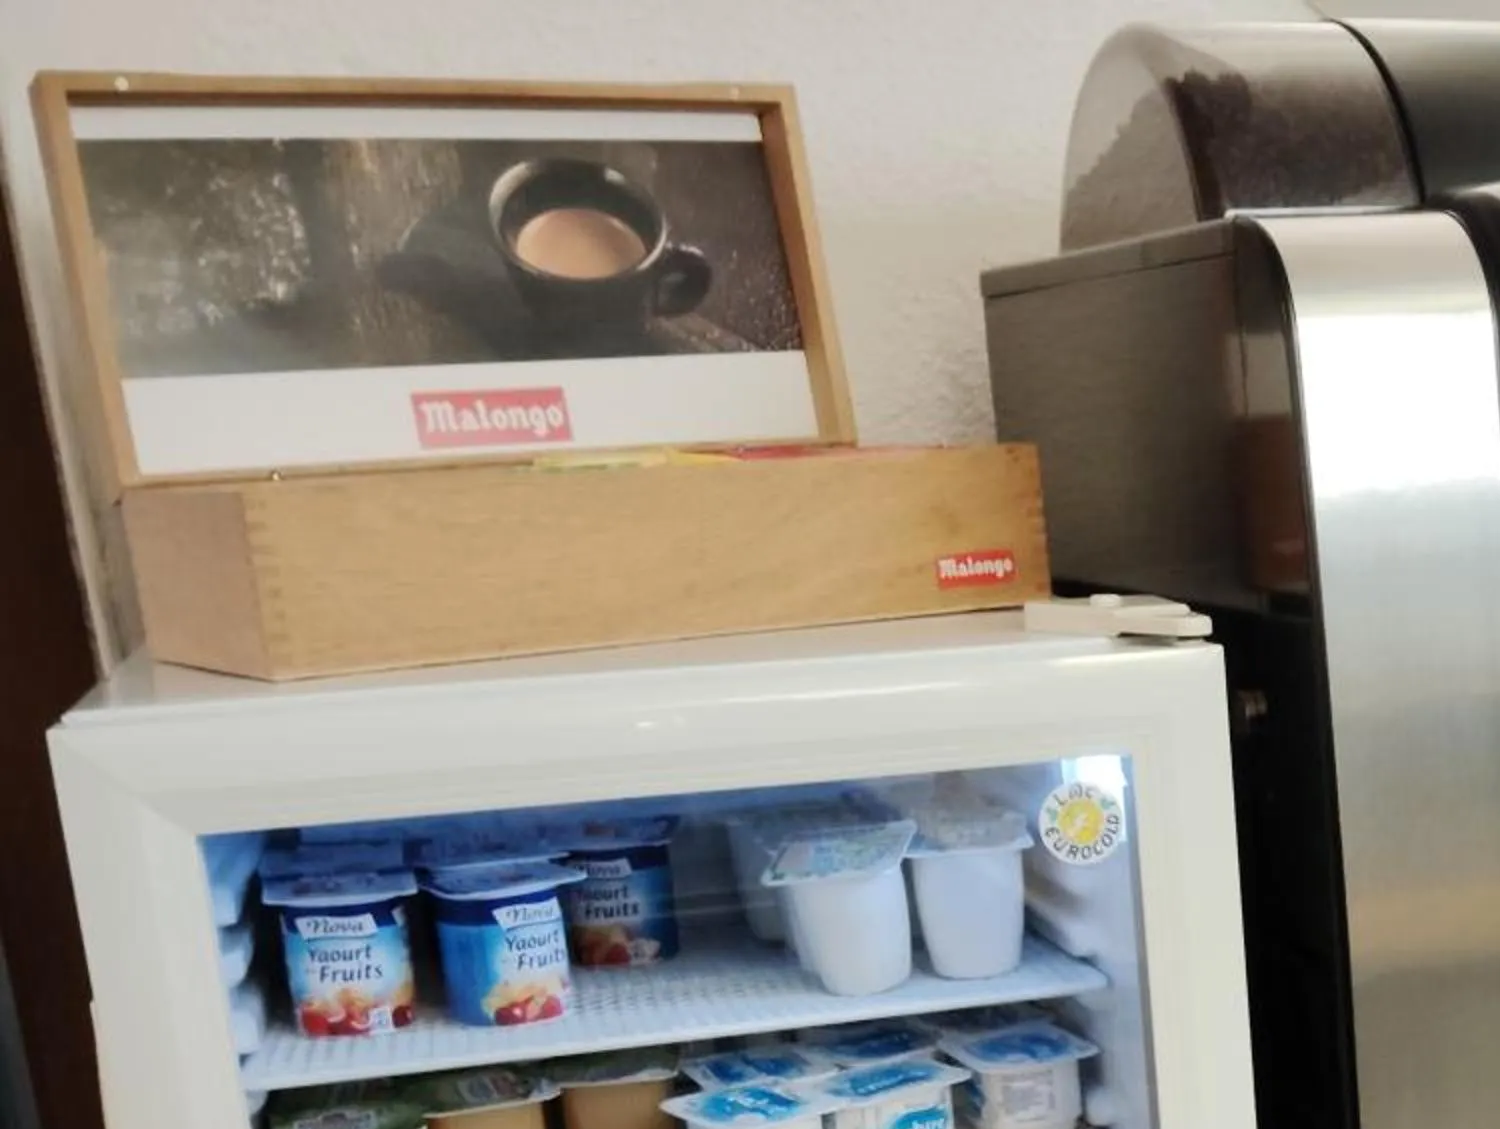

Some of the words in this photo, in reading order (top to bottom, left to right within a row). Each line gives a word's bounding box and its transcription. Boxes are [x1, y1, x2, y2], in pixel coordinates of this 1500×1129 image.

[419, 399, 565, 438] Malongo
[938, 555, 1013, 579] Malongo
[505, 929, 559, 952] Yaourt
[308, 943, 372, 963] Yaourt
[319, 964, 384, 982] Fruits
